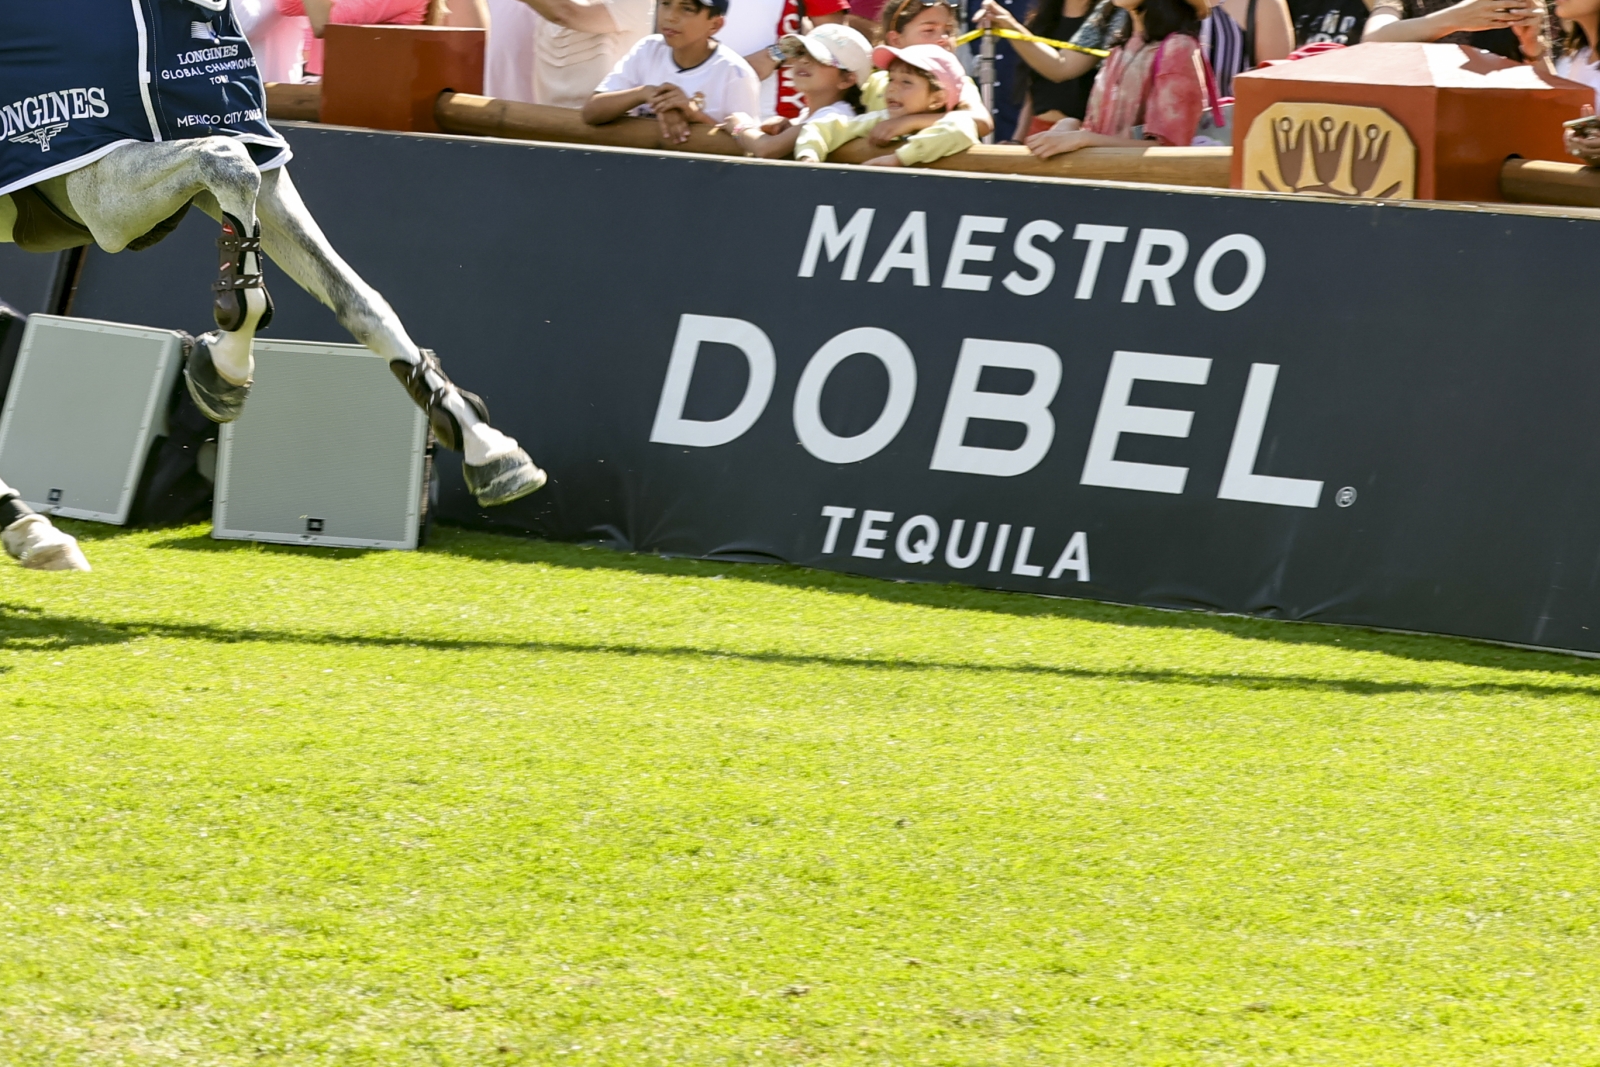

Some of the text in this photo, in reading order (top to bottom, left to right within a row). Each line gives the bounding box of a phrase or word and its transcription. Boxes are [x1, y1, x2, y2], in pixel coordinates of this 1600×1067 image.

[161, 57, 257, 80] GLOBAL CHAMPIONS
[177, 44, 238, 65] LONGINES
[177, 114, 221, 128] MEXICO
[223, 110, 242, 125] CITY
[797, 204, 1266, 312] MAESTRO
[649, 313, 1325, 509] DOBEL
[821, 505, 1091, 583] TEQUILA
